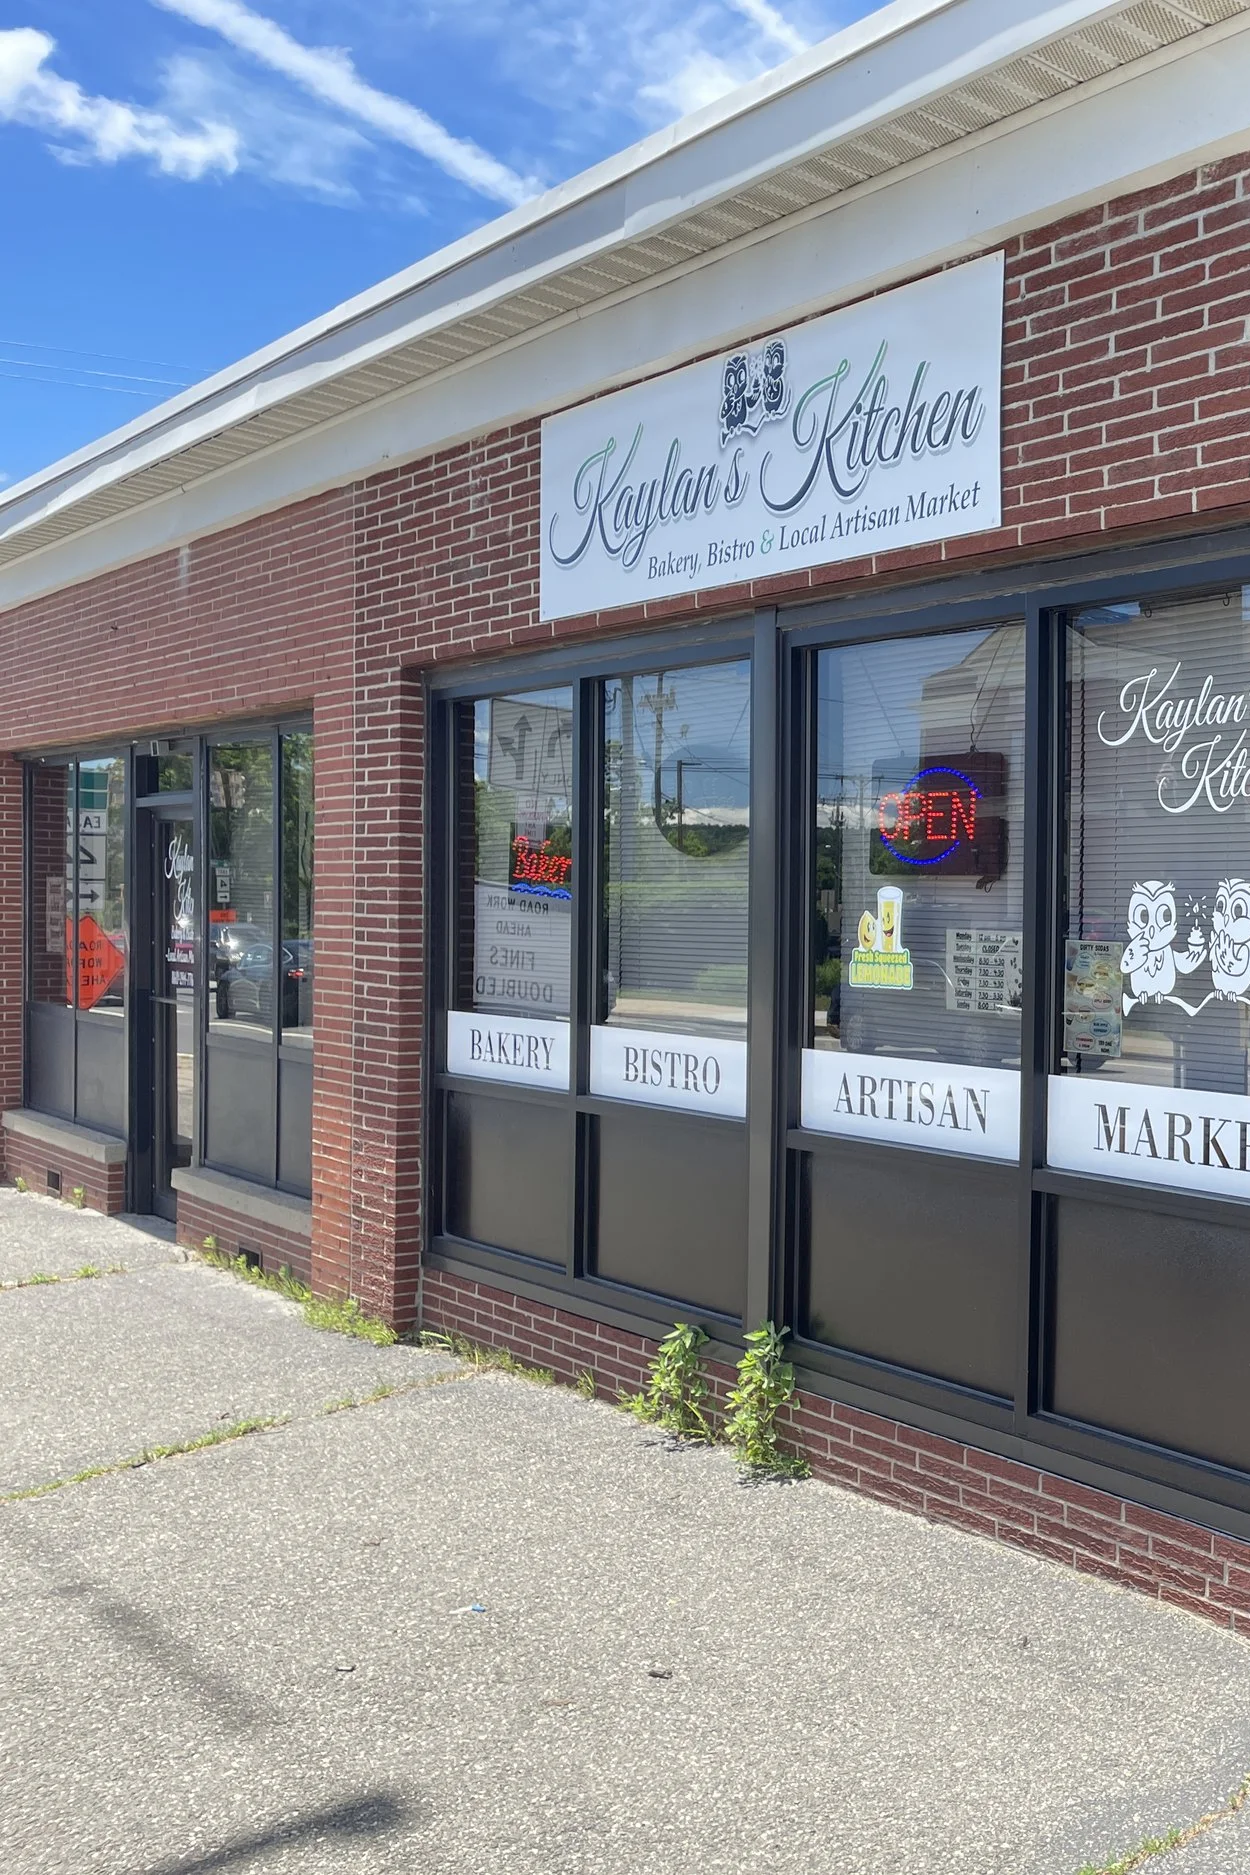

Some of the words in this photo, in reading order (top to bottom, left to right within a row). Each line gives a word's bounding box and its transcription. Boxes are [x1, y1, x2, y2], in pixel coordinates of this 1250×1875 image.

[549, 422, 748, 567] Kaylans
[759, 338, 981, 512] Kitchen
[647, 552, 702, 580] Bakery,
[707, 536, 755, 567] Bistro
[759, 529, 775, 555] &
[778, 514, 828, 551] Local
[829, 507, 901, 540] Artisan
[903, 480, 981, 524] Market
[879, 790, 976, 841] OPEN
[512, 835, 572, 885] Baker
[851, 963, 911, 987] LEMONADE
[854, 950, 874, 962] Fresh
[874, 949, 908, 964] Squeezed
[470, 1028, 555, 1072] BAKERY
[623, 1046, 722, 1095] BISTRO
[833, 1072, 990, 1135] ARTISAN
